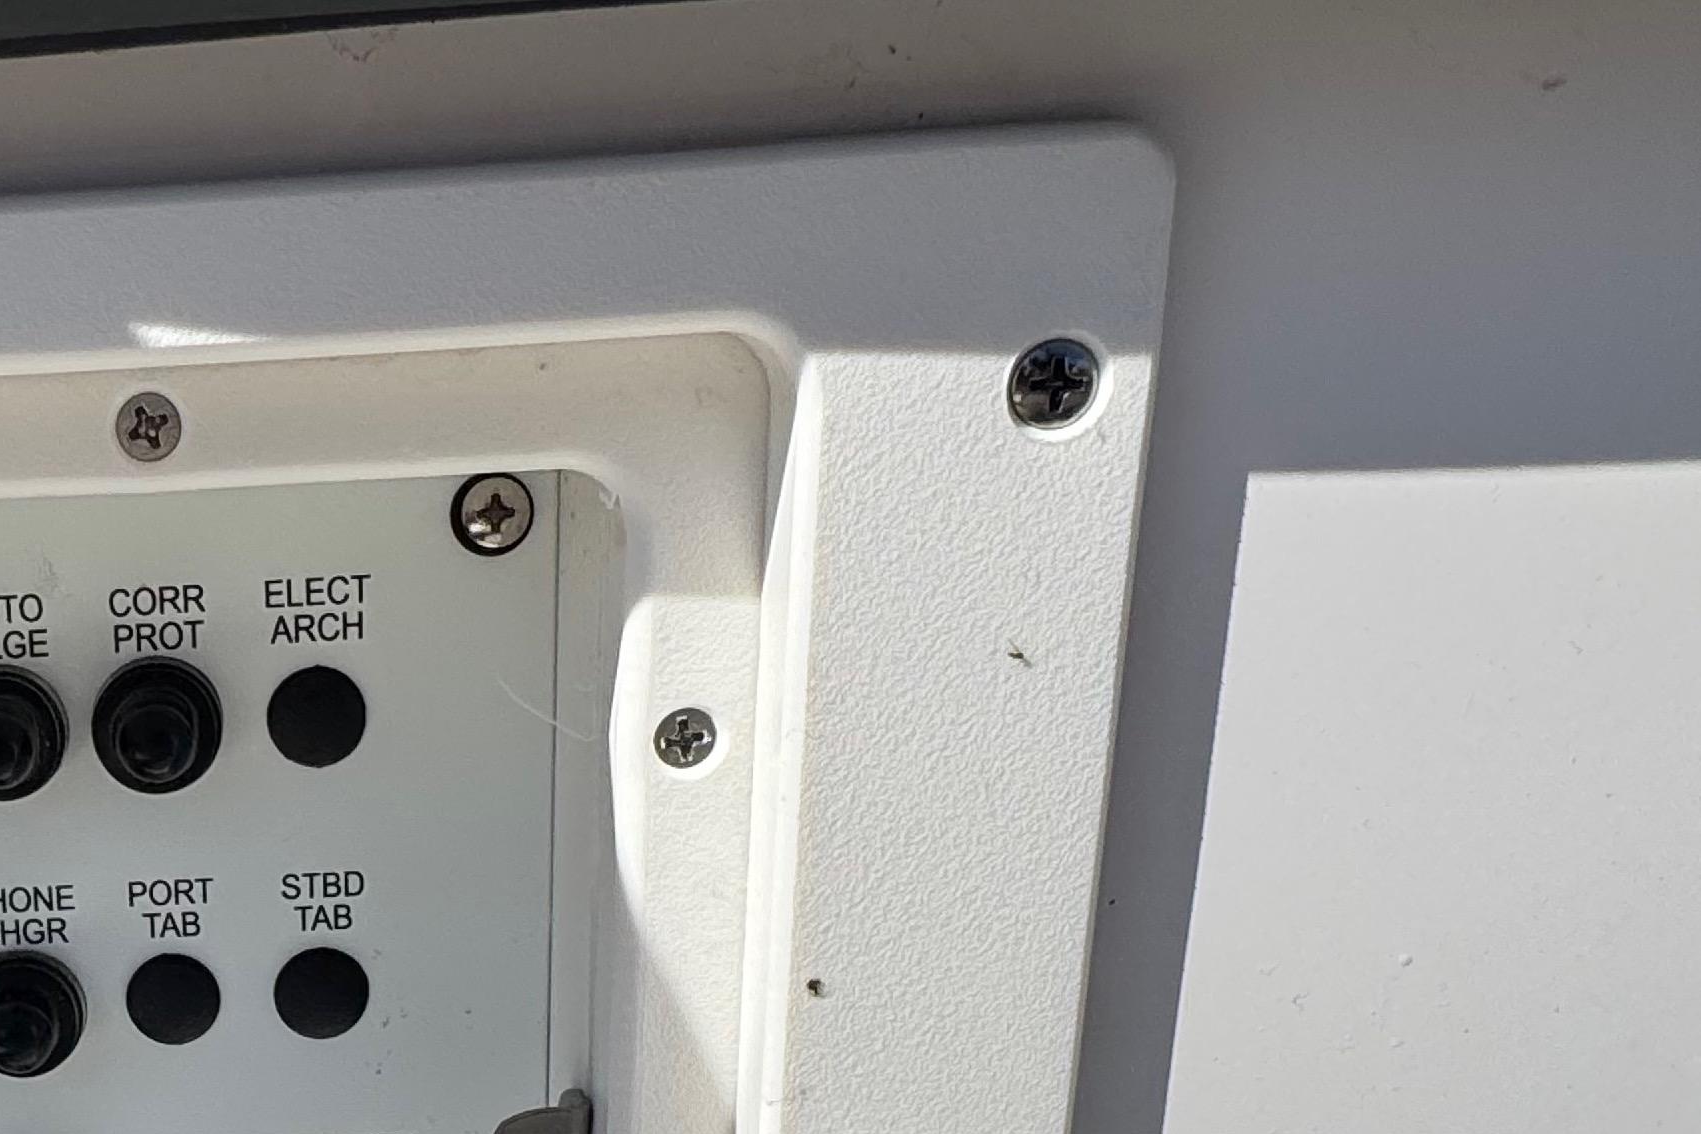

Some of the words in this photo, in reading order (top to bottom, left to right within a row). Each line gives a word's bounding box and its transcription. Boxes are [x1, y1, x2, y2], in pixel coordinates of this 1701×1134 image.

[108, 585, 205, 617] CORR
[264, 575, 371, 608] ELECT
[113, 621, 205, 653] PROT
[271, 611, 364, 644] ARCH
[128, 878, 214, 907] PORT
[281, 870, 365, 900] STBD
[142, 911, 201, 939] TAB
[294, 904, 353, 932] TAB
